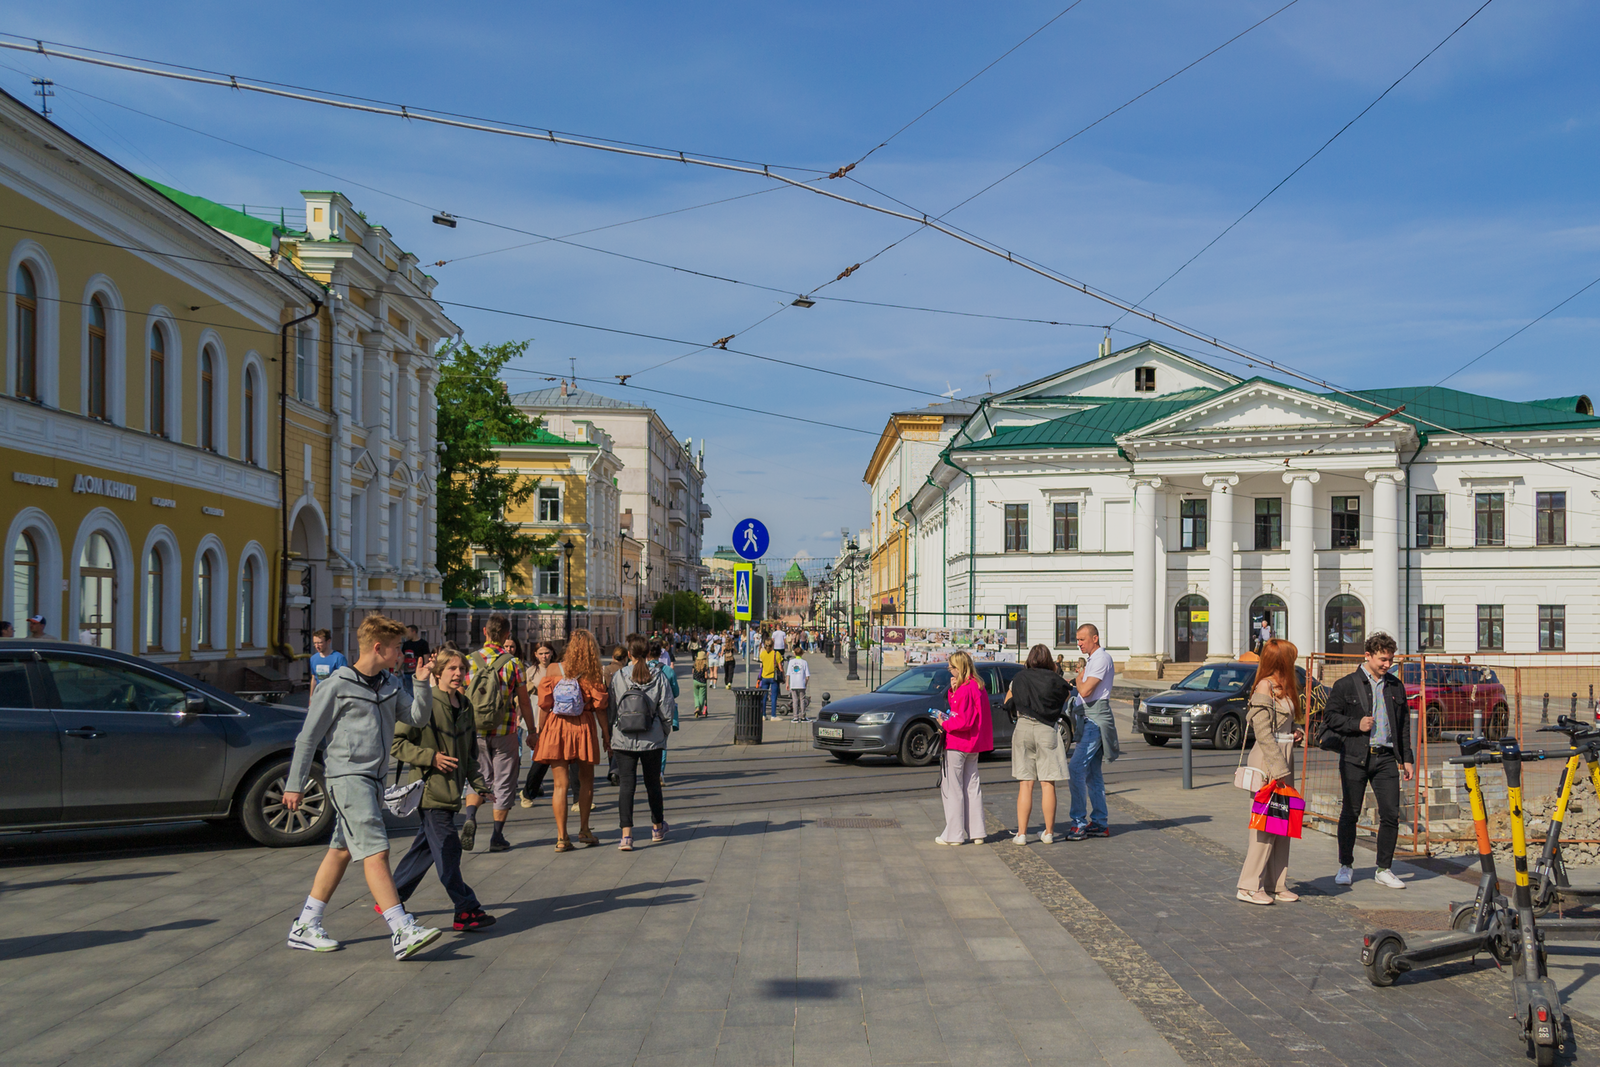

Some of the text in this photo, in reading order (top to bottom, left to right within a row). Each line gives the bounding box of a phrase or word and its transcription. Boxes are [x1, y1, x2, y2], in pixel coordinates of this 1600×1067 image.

[73, 474, 137, 502] ДОМ КНИГИ
[1299, 684, 1329, 715] AXI
